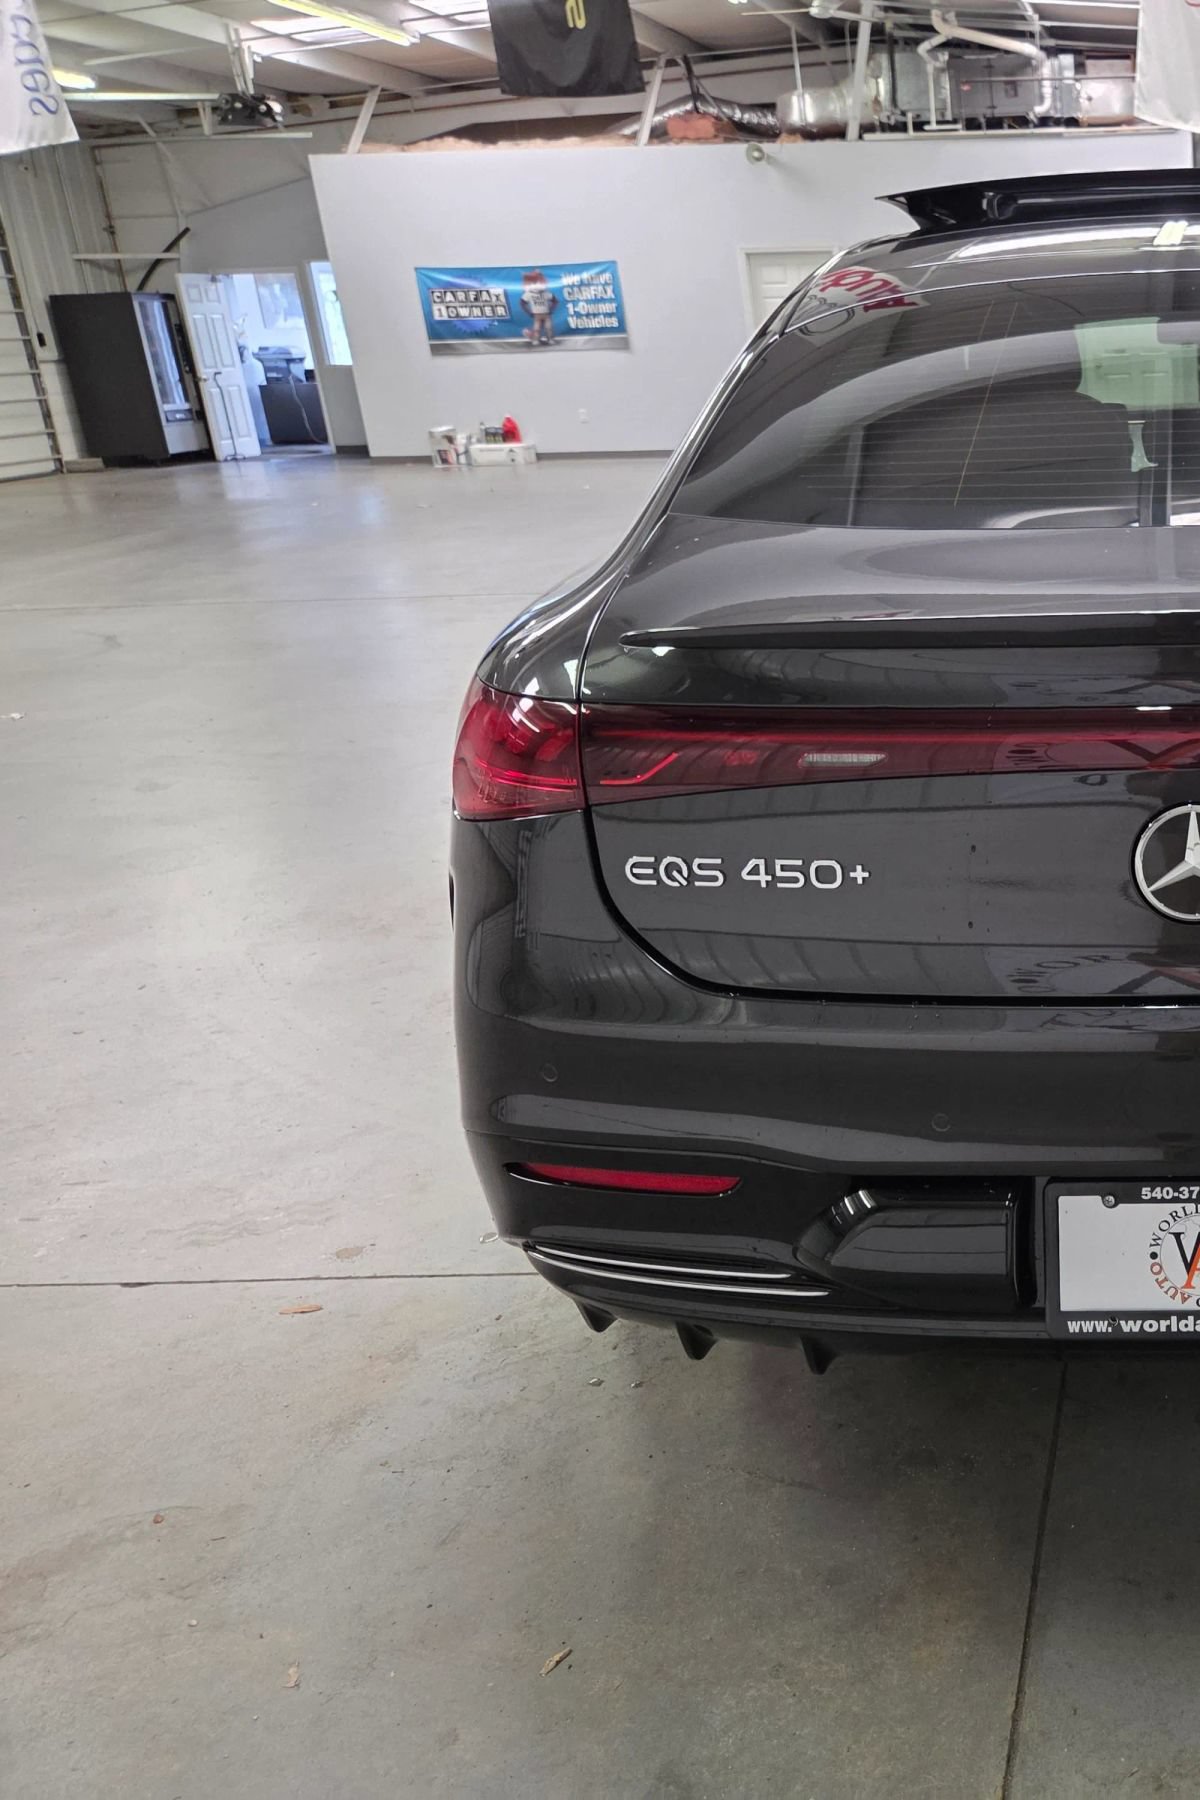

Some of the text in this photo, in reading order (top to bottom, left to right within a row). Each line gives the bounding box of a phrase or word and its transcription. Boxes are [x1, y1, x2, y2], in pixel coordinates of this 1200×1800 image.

[432, 290, 506, 303] CARFAX
[563, 285, 616, 300] CARFAX
[566, 302, 618, 315] 1-Owner
[568, 315, 619, 328] Vehicles
[625, 856, 870, 889] EQS 450+
[1150, 1262, 1193, 1305] AUTO
